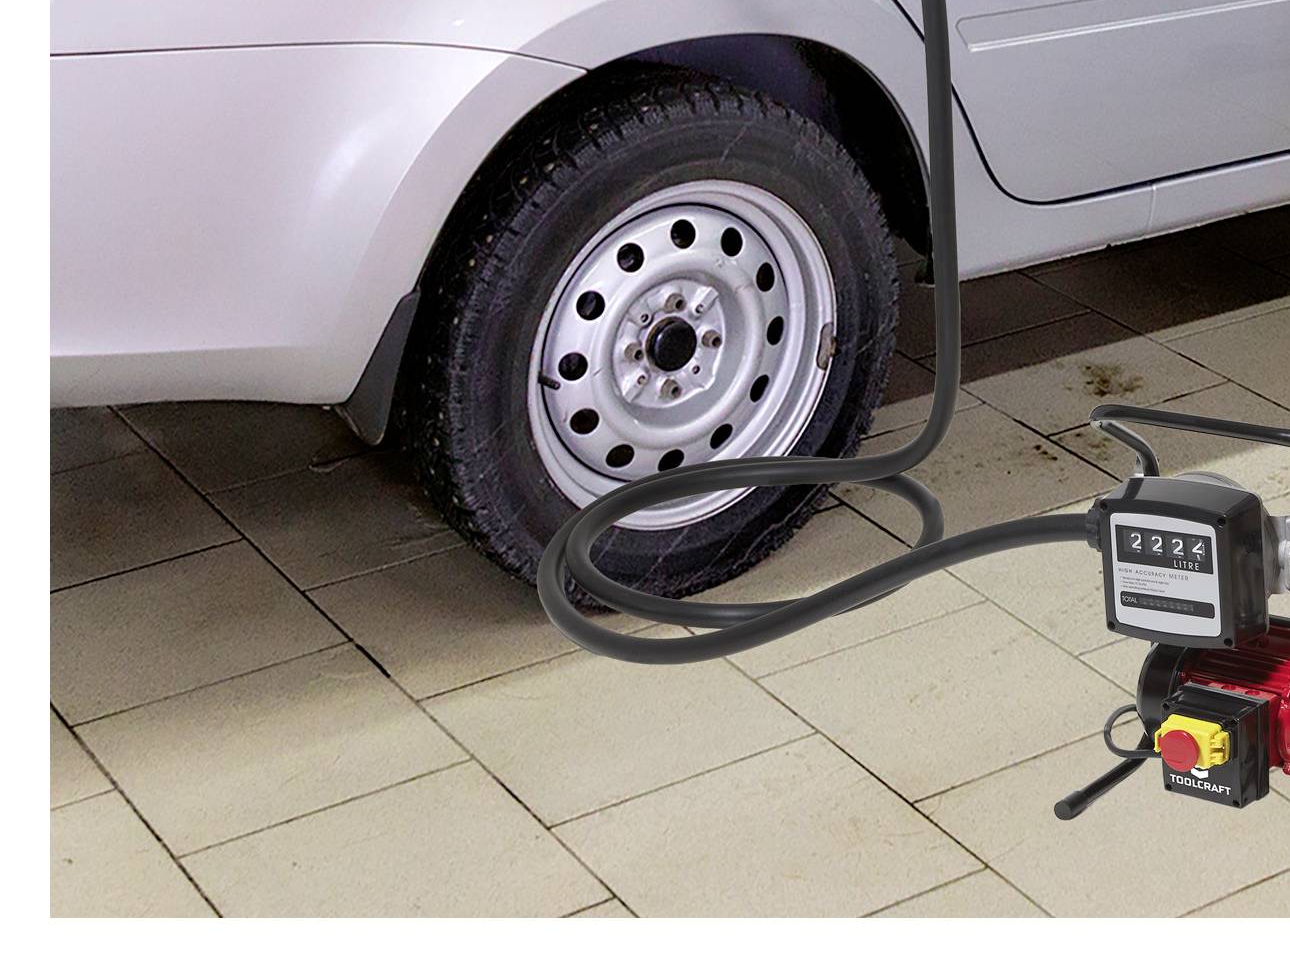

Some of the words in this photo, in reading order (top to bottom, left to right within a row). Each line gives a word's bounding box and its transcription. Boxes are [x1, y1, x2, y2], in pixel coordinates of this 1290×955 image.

[1173, 559, 1200, 571] LITRE
[1135, 569, 1167, 578] ACCURACY
[1168, 573, 1188, 581] METER
[1169, 773, 1231, 795] TOOLCRAFT
